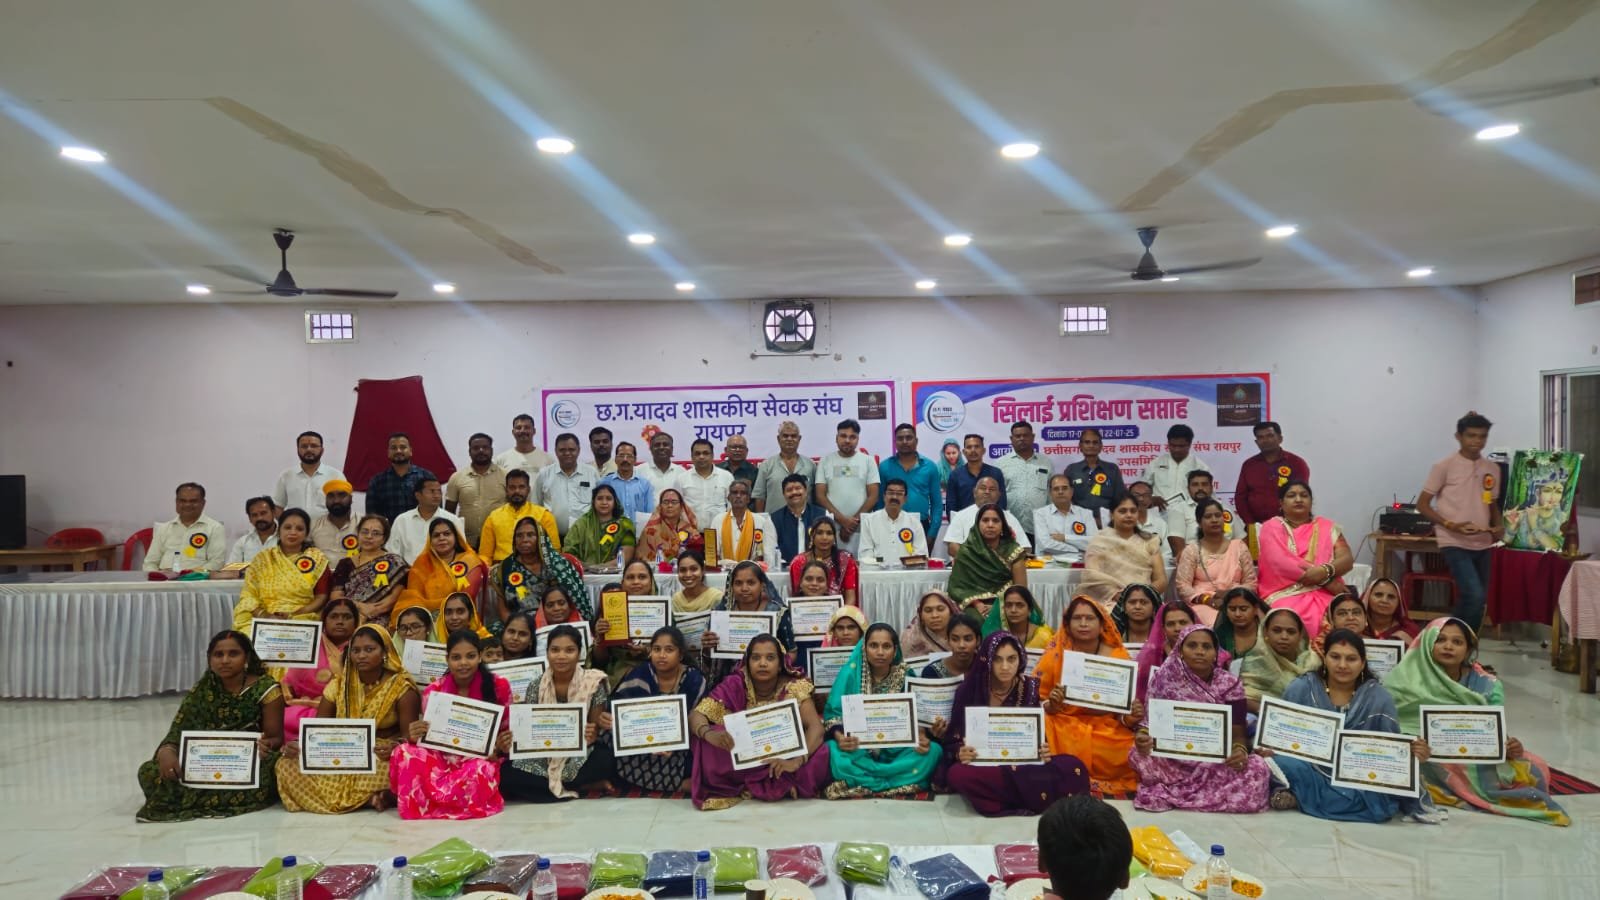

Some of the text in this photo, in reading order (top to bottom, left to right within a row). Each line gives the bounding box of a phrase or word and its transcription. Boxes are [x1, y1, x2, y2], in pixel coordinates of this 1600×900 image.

[594, 402, 678, 421] छ.ग.यादव
[682, 394, 759, 419] शासकीय
[761, 393, 809, 416] सेवक
[812, 392, 843, 415] संघ
[991, 395, 1055, 423] सिलाई
[1057, 394, 1133, 421] प्रशिक्षण
[1136, 398, 1190, 420] सप्ताह
[1104, 428, 1135, 438] 22-07-25
[1119, 441, 1161, 454] शासकीय
[1193, 441, 1210, 453] संघ
[1214, 441, 1242, 454] रायपुर
